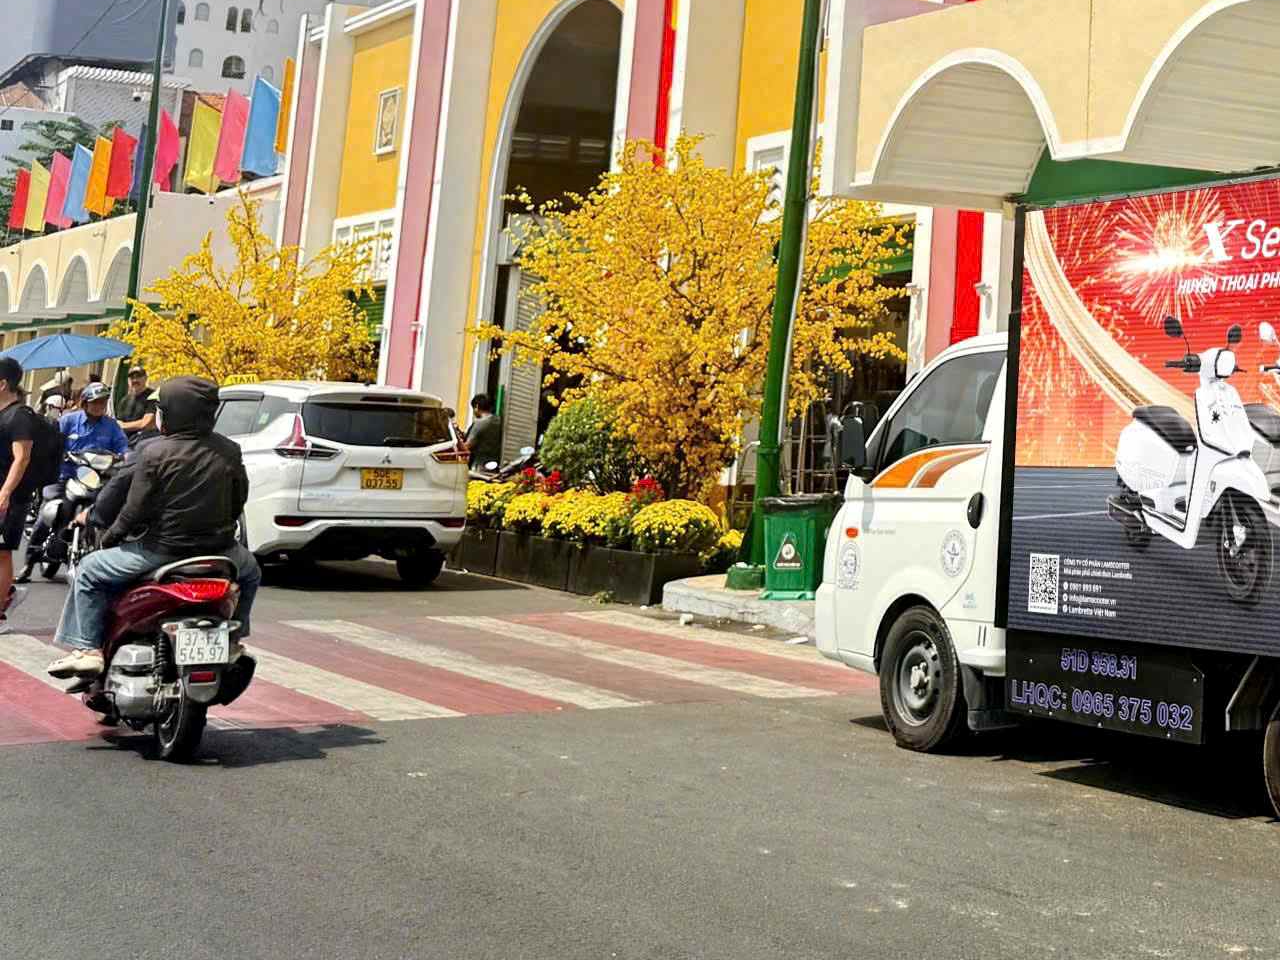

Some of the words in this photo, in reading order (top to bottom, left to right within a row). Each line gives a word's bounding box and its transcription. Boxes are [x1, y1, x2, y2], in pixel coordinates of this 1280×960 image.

[1201, 219, 1245, 262] X
[1221, 272, 1259, 293] THOẠI
[1011, 679, 1067, 710] LHQC:
[1072, 689, 1114, 718] 0965
[1118, 696, 1152, 724] 375
[1156, 701, 1193, 731] 032
